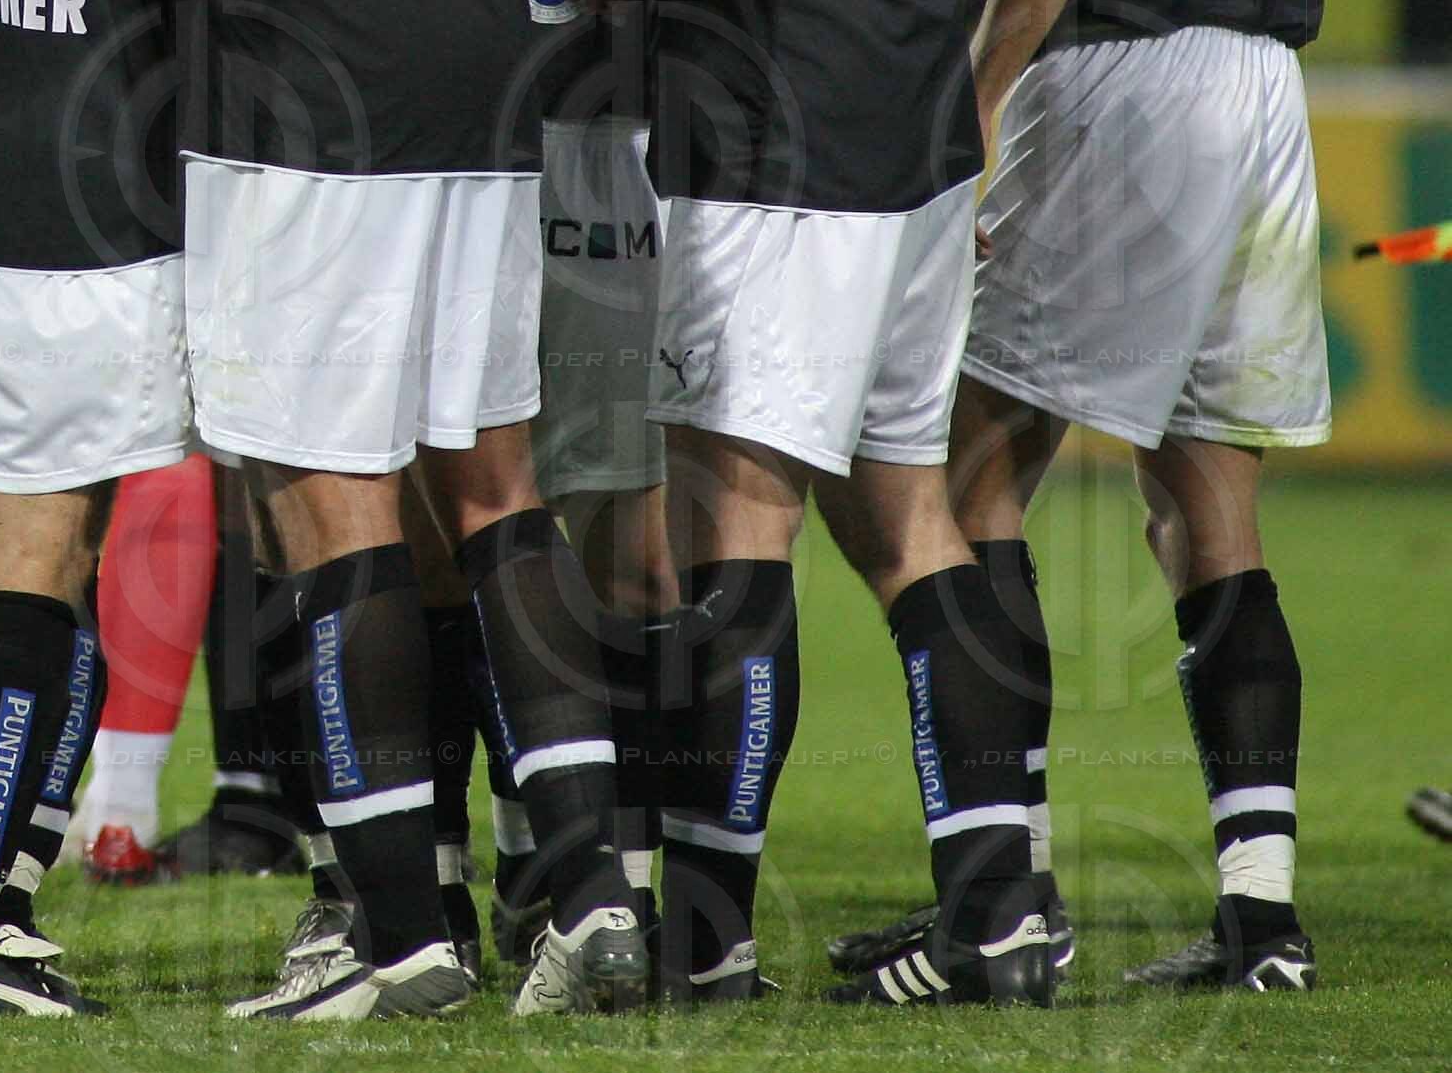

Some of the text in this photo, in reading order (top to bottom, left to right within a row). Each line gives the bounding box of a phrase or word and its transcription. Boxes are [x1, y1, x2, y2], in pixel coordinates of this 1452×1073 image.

[45, 636, 96, 795] PUNTIGAMER
[728, 662, 771, 821] PUNTIGAMER
[910, 657, 945, 812] PUNTIGAMER
